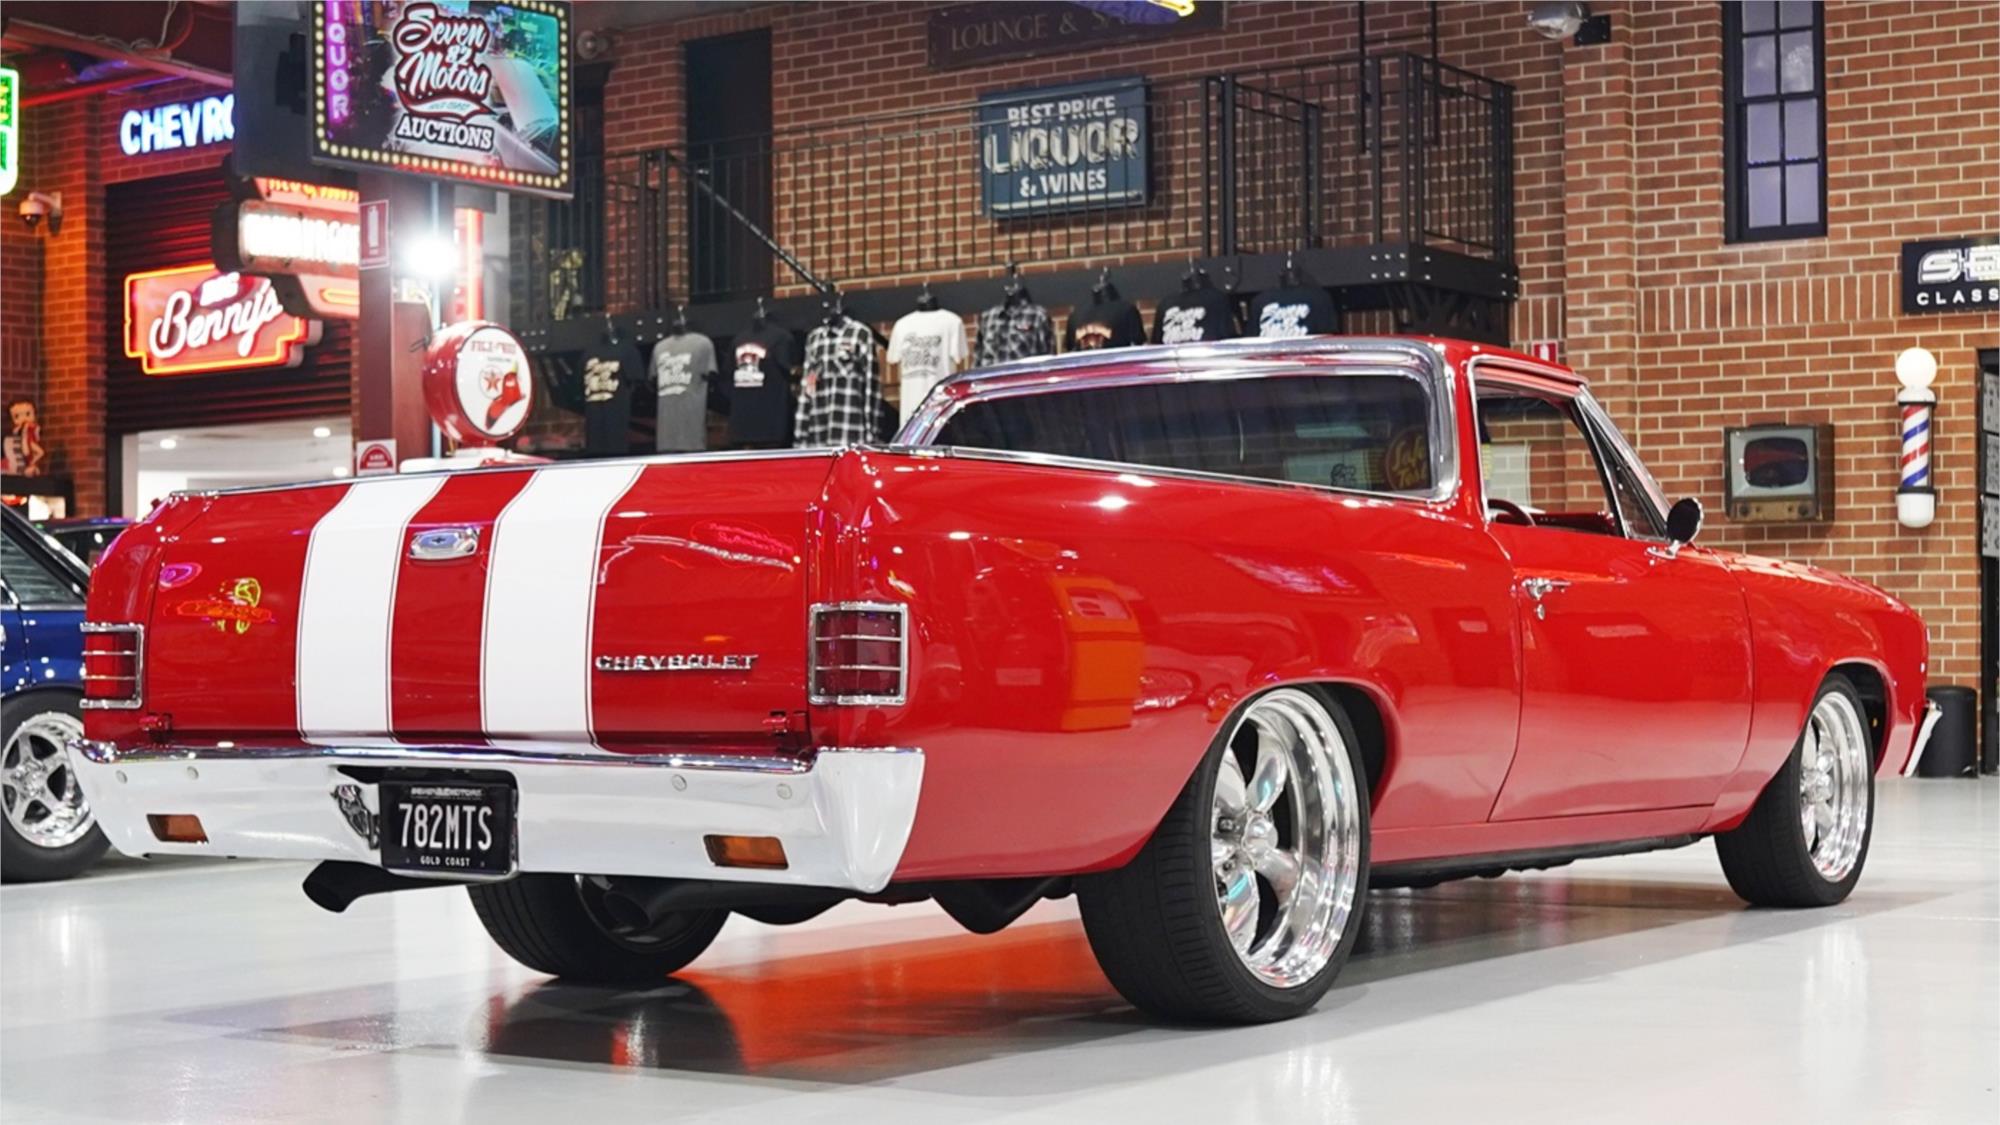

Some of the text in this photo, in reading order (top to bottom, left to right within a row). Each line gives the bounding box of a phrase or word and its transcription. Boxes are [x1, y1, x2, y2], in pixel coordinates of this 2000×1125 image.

[399, 6, 486, 53] Seven
[951, 14, 1048, 51] LOUNGE
[1058, 13, 1078, 36] &
[446, 45, 470, 66] 82
[399, 52, 487, 97] Motors
[1007, 95, 1116, 127] BEST PRICE
[397, 116, 493, 149] AUCTIONS
[984, 118, 1139, 173] LIQUOR
[1020, 169, 1107, 197] & WINES
[148, 278, 284, 359] Benny's
[595, 654, 758, 671] CHEVROLET
[399, 803, 492, 850] 782MTS
[420, 855, 471, 868] GOLD COAST
